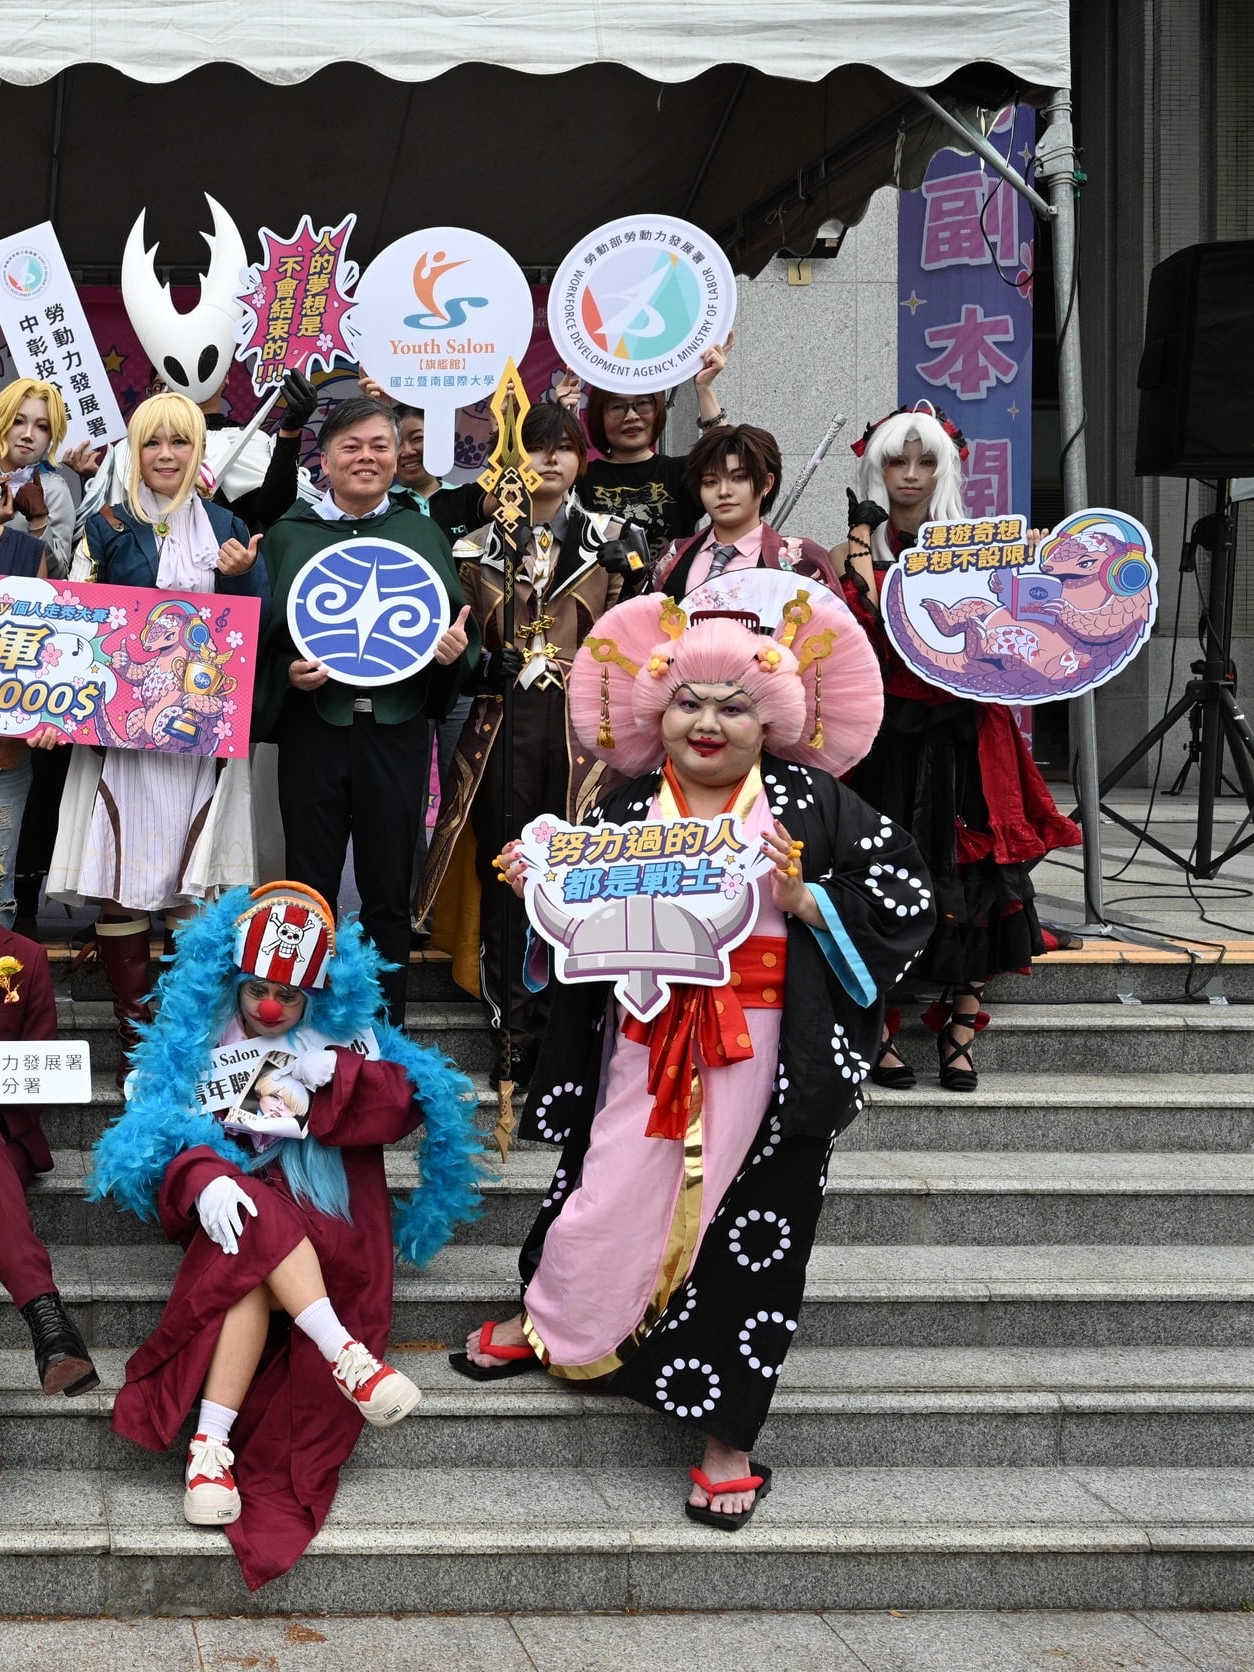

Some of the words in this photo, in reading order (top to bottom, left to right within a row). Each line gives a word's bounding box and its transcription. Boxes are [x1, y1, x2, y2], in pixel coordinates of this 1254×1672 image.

[584, 229, 706, 266] 勞動部勞動力發展署
[297, 232, 336, 337] 人的夢想是
[564, 269, 585, 331] WORKFORCE
[702, 267, 719, 300] LABOR
[707, 304, 719, 317] OF
[389, 339, 443, 354] Youth
[446, 339, 495, 354] Salon
[570, 331, 631, 377] DEVELOPMENT
[678, 320, 714, 363] MINISTRY
[44, 302, 108, 438] 勞動力發展署
[390, 375, 495, 388] 國立暨南國際大學
[632, 361, 678, 377] AGENCY,
[924, 519, 1021, 548] 漫遊奇想
[905, 545, 1035, 575] 夢想不設限!
[12, 600, 109, 623] 個人走秀大賽
[547, 818, 746, 864] 努力過的人
[563, 860, 725, 903] 都是戰士
[220, 1048, 260, 1067] Salon
